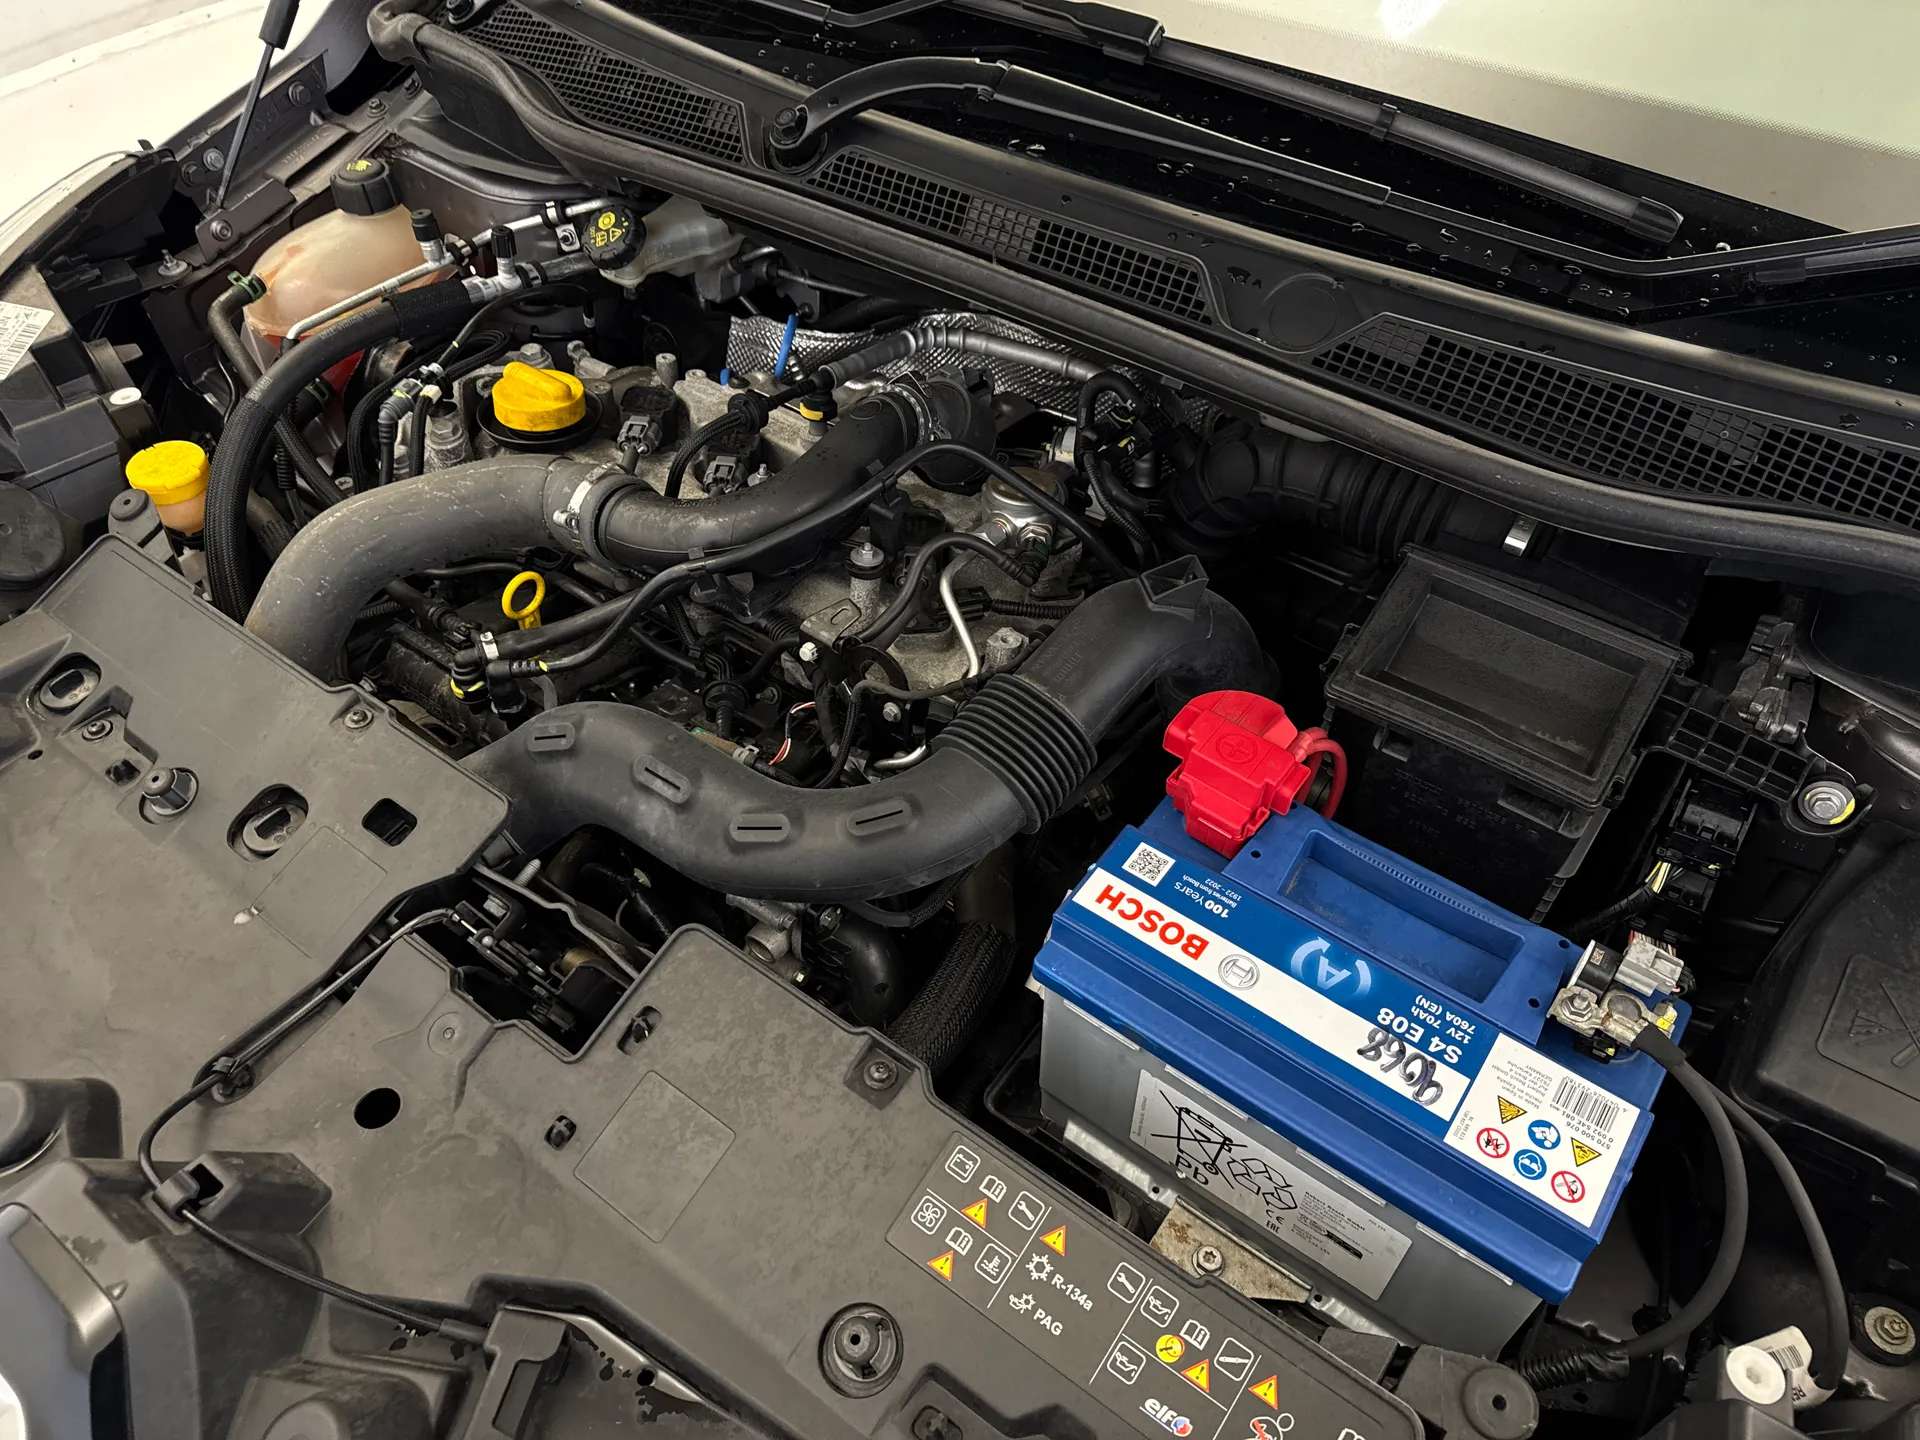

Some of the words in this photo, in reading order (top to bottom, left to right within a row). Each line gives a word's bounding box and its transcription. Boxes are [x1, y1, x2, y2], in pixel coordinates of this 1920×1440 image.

[1182, 873, 1200, 886] Bosch
[1199, 883, 1213, 894] from
[1204, 877, 1221, 890] 2022
[1172, 880, 1207, 906] Years
[1212, 890, 1238, 907] Batteries
[1225, 889, 1242, 901] 1922
[1203, 898, 1231, 918] 100
[1094, 883, 1210, 961] BOSCH
[1414, 992, 1444, 1015] (EN)
[1374, 1005, 1425, 1043] E08
[1409, 1005, 1443, 1028] 70Ah
[1444, 1010, 1477, 1034] 760A
[1445, 1024, 1472, 1044] 12V
[1426, 1034, 1464, 1064] S4
[1356, 1027, 1444, 1107] 9068
[1491, 1063, 1509, 1076] GmbH
[1524, 1063, 1553, 1082] GERMANY
[1509, 1073, 1527, 1086] Bosch
[1501, 1084, 1518, 1097] Spain
[1527, 1083, 1546, 1097] Robert
[1523, 1097, 1540, 1110] Made
[1561, 1110, 1575, 1121] 081
[1565, 1120, 1579, 1132] 076
[1580, 1129, 1595, 1141] 500
[1591, 1127, 1607, 1139] 092
[1597, 1138, 1611, 1150] 570
[1173, 1154, 1213, 1187] Pb
[1050, 1272, 1096, 1311] R-134a
[1031, 1308, 1065, 1337] PAG
[1143, 1398, 1178, 1425] elf
